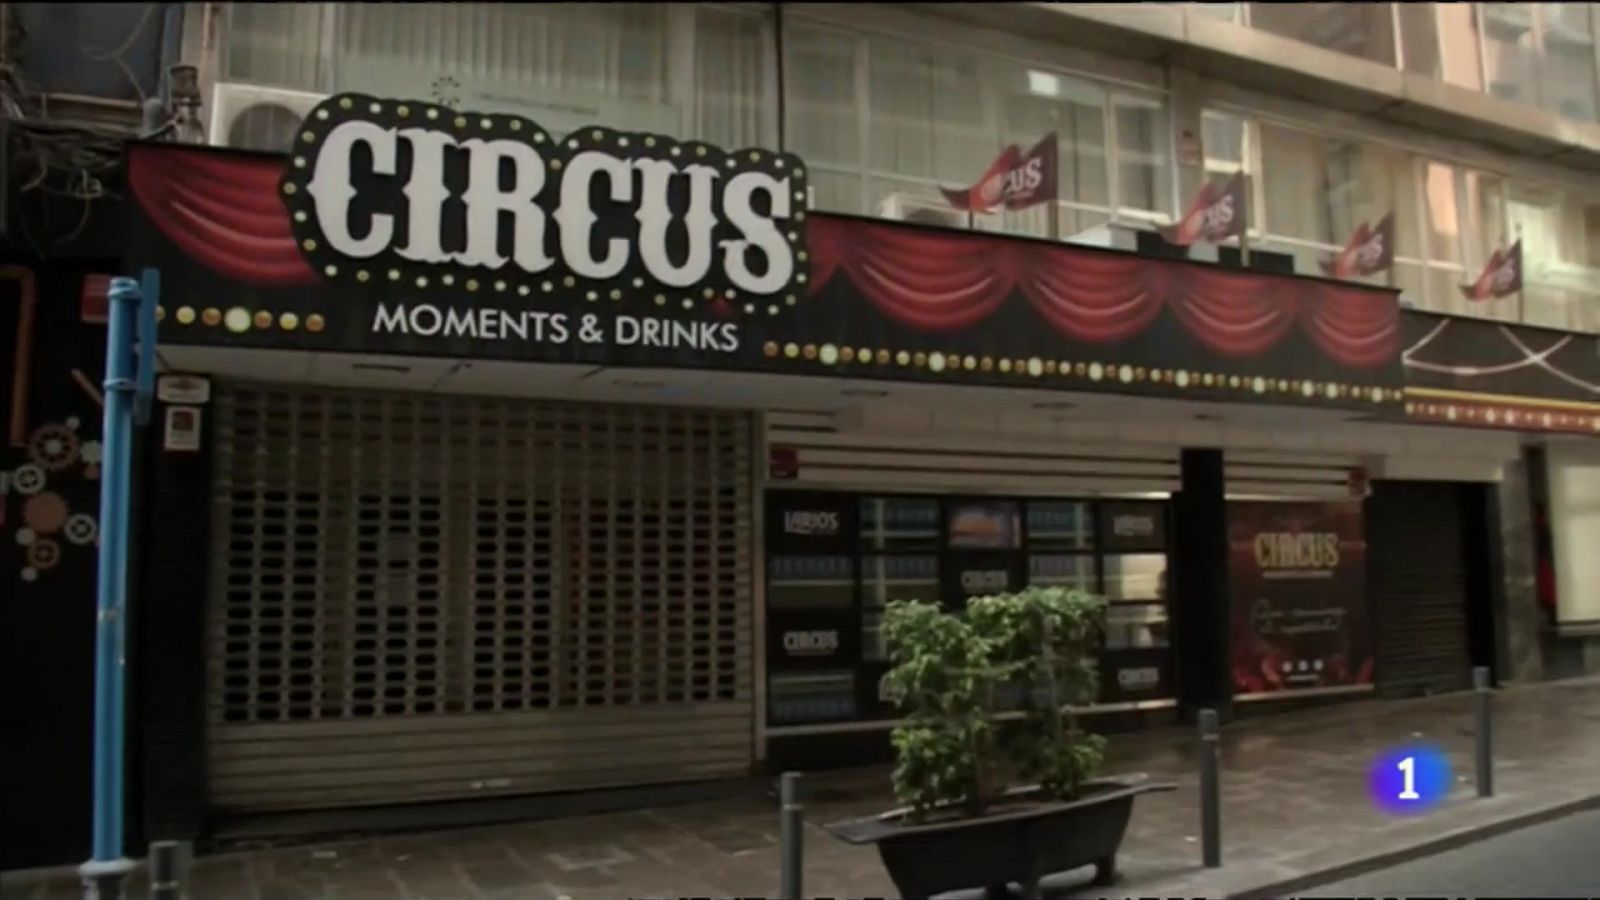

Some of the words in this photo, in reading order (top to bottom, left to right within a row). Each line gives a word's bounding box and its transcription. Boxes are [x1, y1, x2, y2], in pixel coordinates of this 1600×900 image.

[306, 119, 795, 295] CIRCUS
[371, 302, 569, 344] MOMENTS
[578, 313, 603, 343] &
[615, 315, 740, 352] DRINKS
[1254, 532, 1339, 568] CIRCUS
